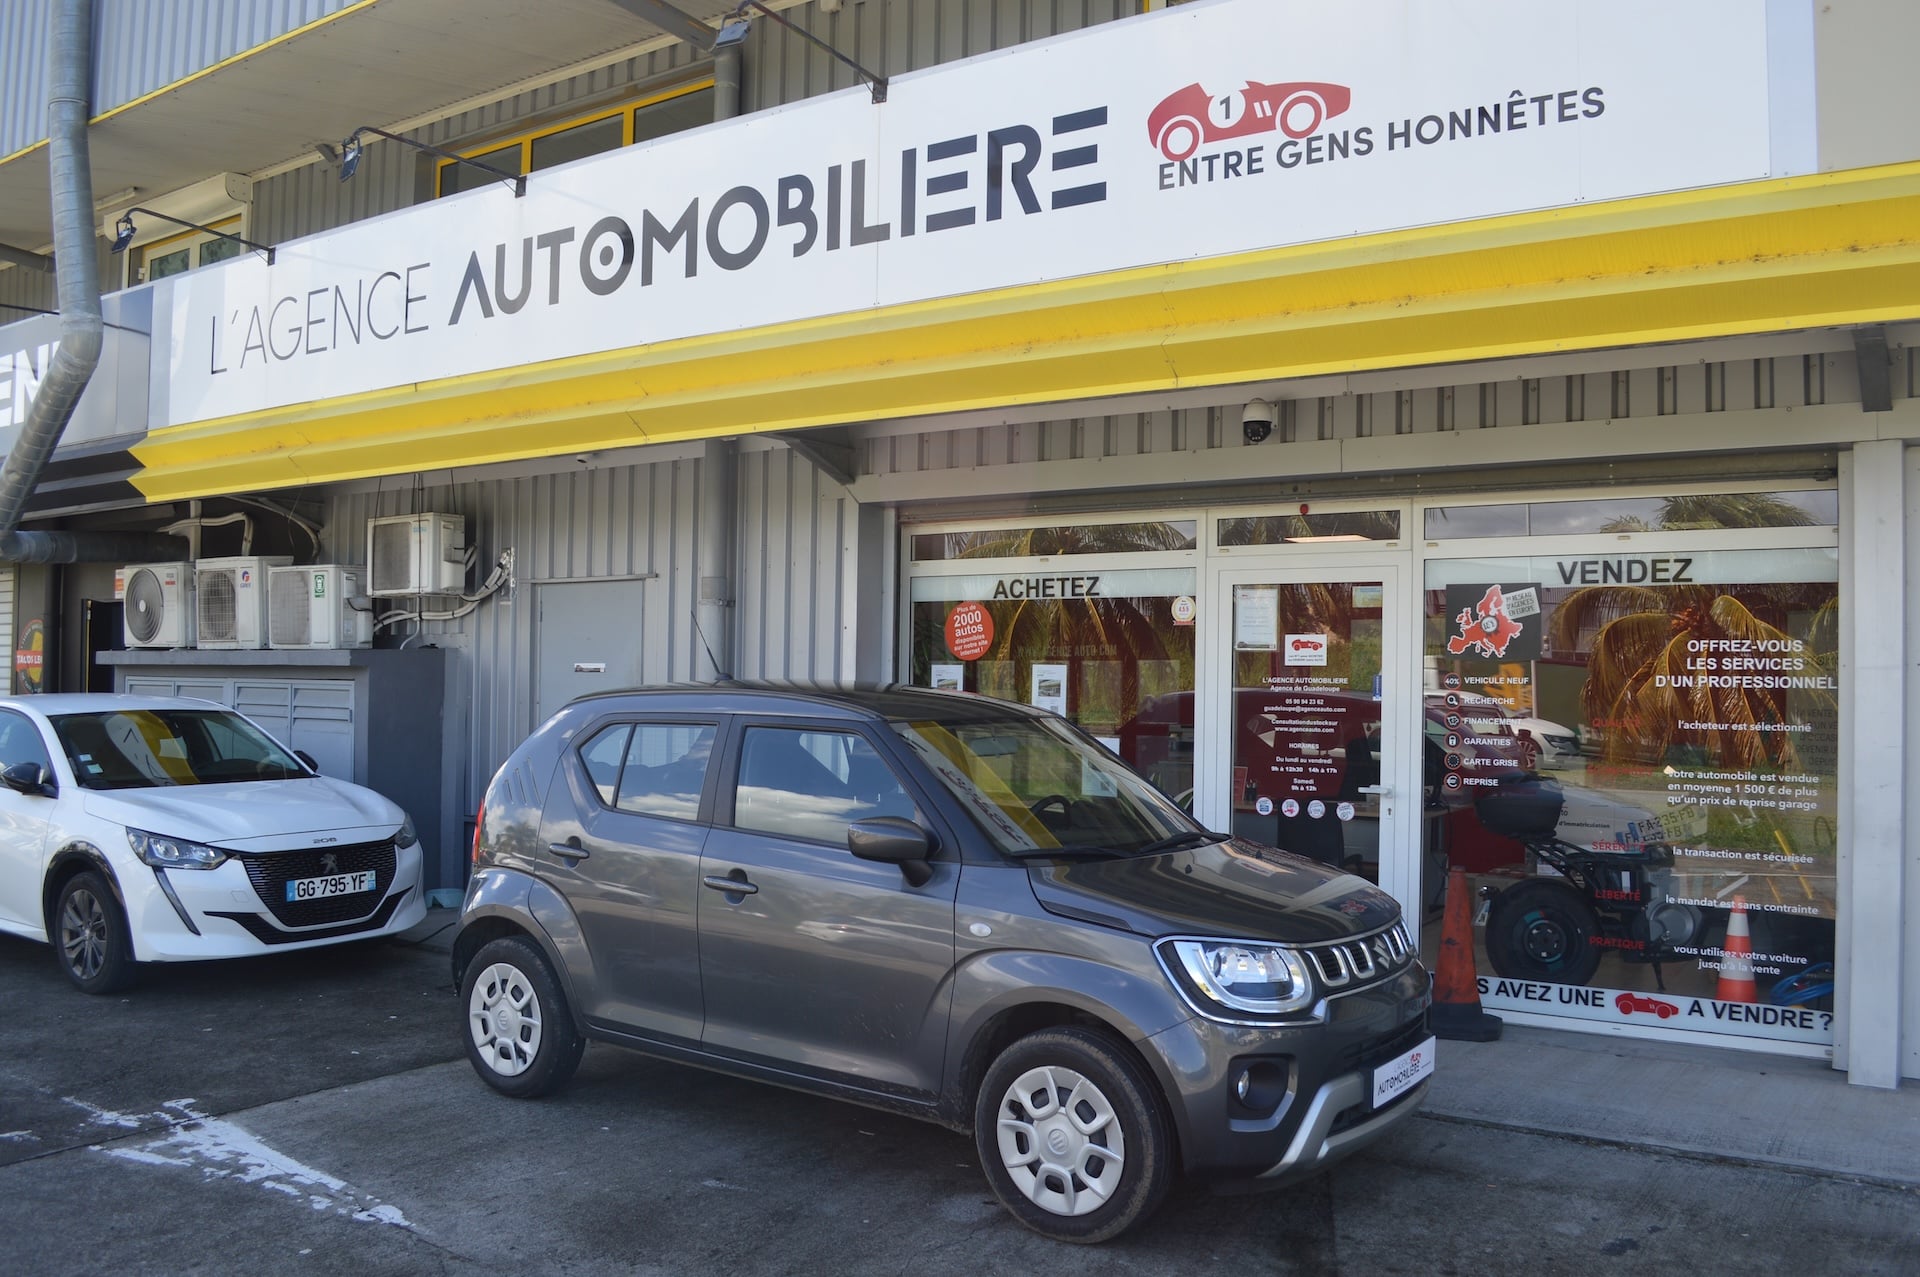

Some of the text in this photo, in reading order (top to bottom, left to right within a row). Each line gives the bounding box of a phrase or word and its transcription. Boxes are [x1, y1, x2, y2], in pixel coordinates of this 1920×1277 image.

[1158, 87, 1606, 191] ENTRE GENS HONNÊTES
[209, 105, 1109, 376] L'AGENCE AUTOMOBILIERE
[1557, 558, 1694, 585] VENDEZ
[992, 576, 1101, 599] ACHETEZ
[953, 610, 982, 628] 2000
[955, 623, 984, 637] autos
[1686, 640, 1804, 653] OFFREZ-VOUS
[1686, 658, 1718, 670] LES
[1721, 657, 1804, 671] SERVICES
[1464, 676, 1529, 685] VEHICULE NEUF
[1655, 675, 1838, 690] D'UN PROFESSIONNEL
[1303, 685, 1340, 693] Guadeloupe
[1464, 697, 1515, 705] RECHERCHE
[1464, 718, 1522, 726] FINANCEMENT
[1678, 719, 1812, 733] l'acheteur est sélectionné
[1288, 742, 1320, 750] HORAIRES
[1463, 737, 1511, 746] GARANTIES
[1463, 758, 1519, 767] CARTE GRISE
[1463, 778, 1499, 787] REPRISE
[1697, 769, 1758, 782] automobile
[1760, 772, 1776, 783] est
[1777, 771, 1819, 784] vendue
[1667, 783, 1818, 798] en moyenne 1 500 € de plus
[1667, 795, 1818, 810] qu'un prix de reprise garage
[313, 837, 337, 845] 208
[1672, 846, 1814, 864] la transaction est sécurisée
[296, 873, 368, 898] GG-795-YF
[1594, 888, 1641, 901] LIBERTÉ
[1665, 894, 1819, 915] le mandat est sans contrainte
[1589, 936, 1645, 950] PRATIQUE
[1673, 946, 1808, 965] vous utilisez votre voiture
[1697, 959, 1780, 976] jusqu'à la vente
[1494, 979, 1552, 1003] AVEZ
[1558, 987, 1605, 1008] UNE
[1687, 999, 1705, 1017] A
[1711, 1001, 1815, 1030] VENDRE
